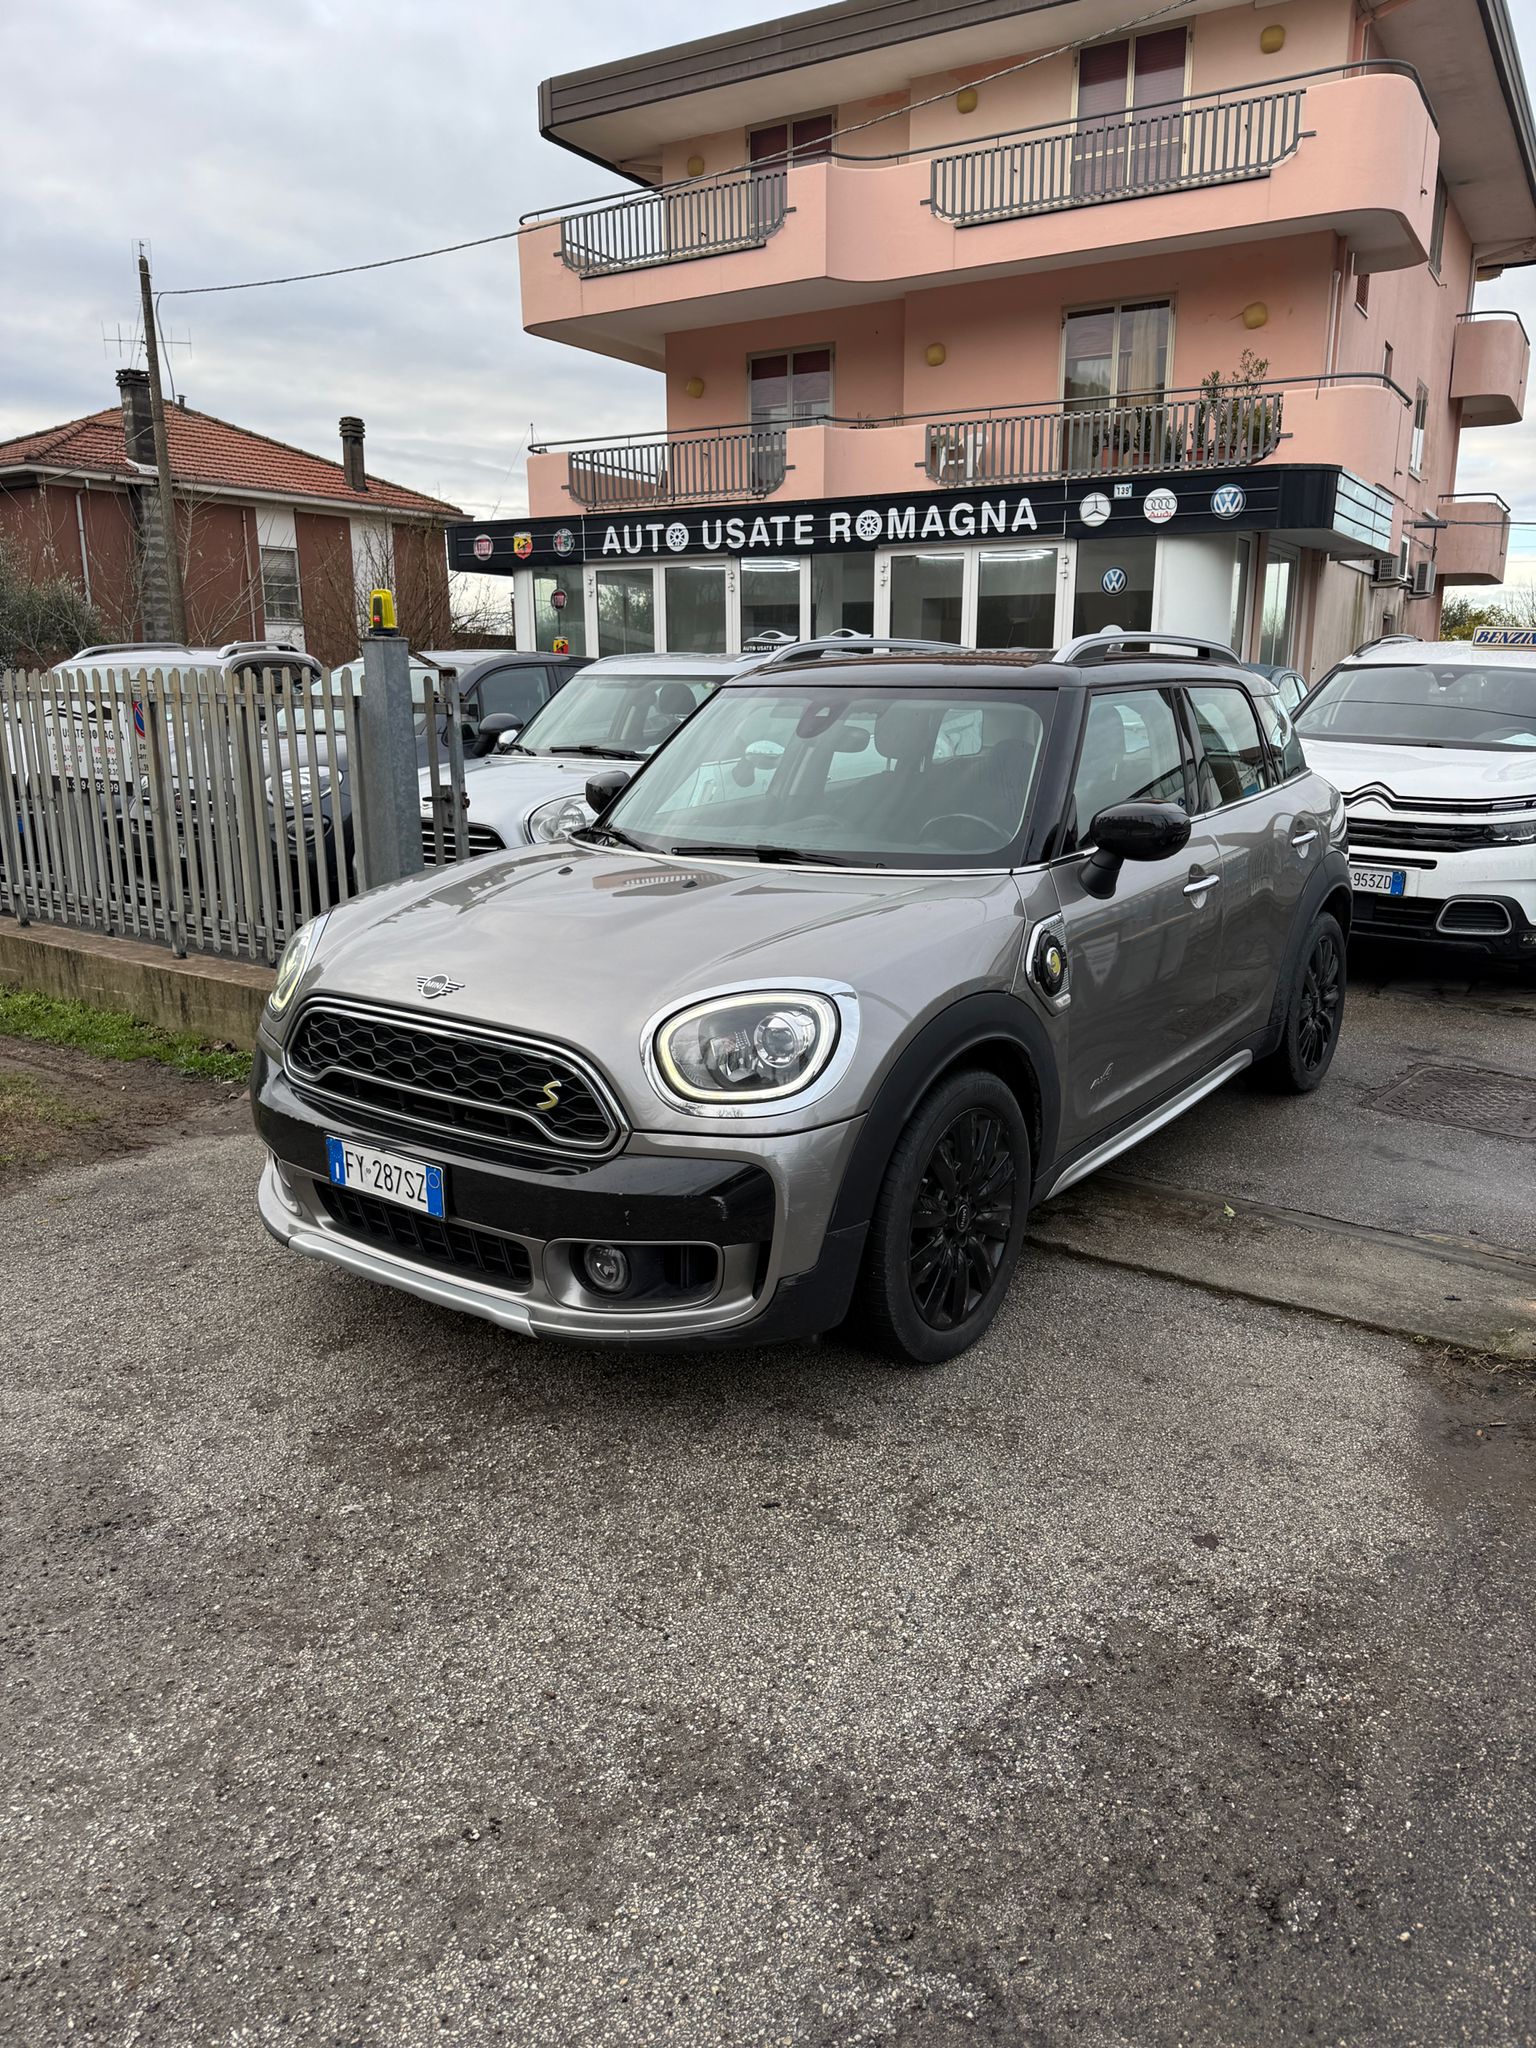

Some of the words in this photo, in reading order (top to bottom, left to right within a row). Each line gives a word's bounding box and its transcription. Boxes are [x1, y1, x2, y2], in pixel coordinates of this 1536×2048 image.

[1116, 486, 1130, 496] 139
[602, 522, 690, 555] AUTO
[702, 514, 814, 550] USATE
[829, 497, 1038, 544] ROMAGNA
[62, 727, 84, 739] UTE
[88, 729, 125, 741] OAGA
[1353, 872, 1392, 890] 953ZD
[536, 1080, 562, 1110] S
[372, 1159, 427, 1204] 287SZ
